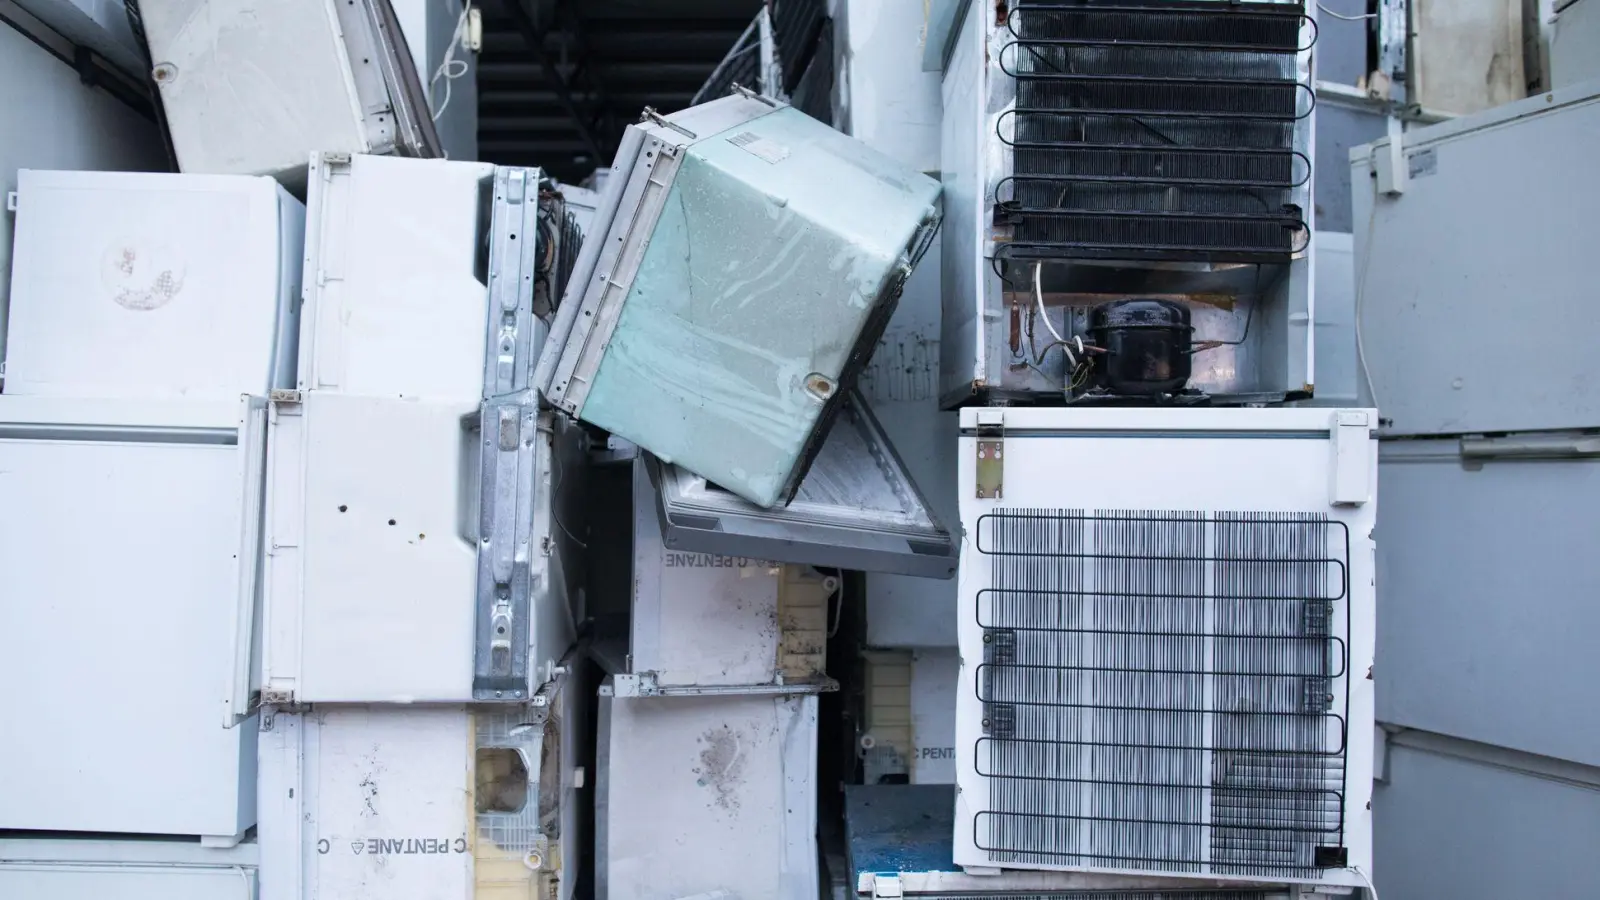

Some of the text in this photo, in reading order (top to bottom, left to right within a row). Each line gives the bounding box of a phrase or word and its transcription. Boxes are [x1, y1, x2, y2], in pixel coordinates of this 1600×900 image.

[666, 553, 733, 568] PENTANE
[922, 747, 956, 760] PENT
[317, 838, 467, 855] C PENTANE C
